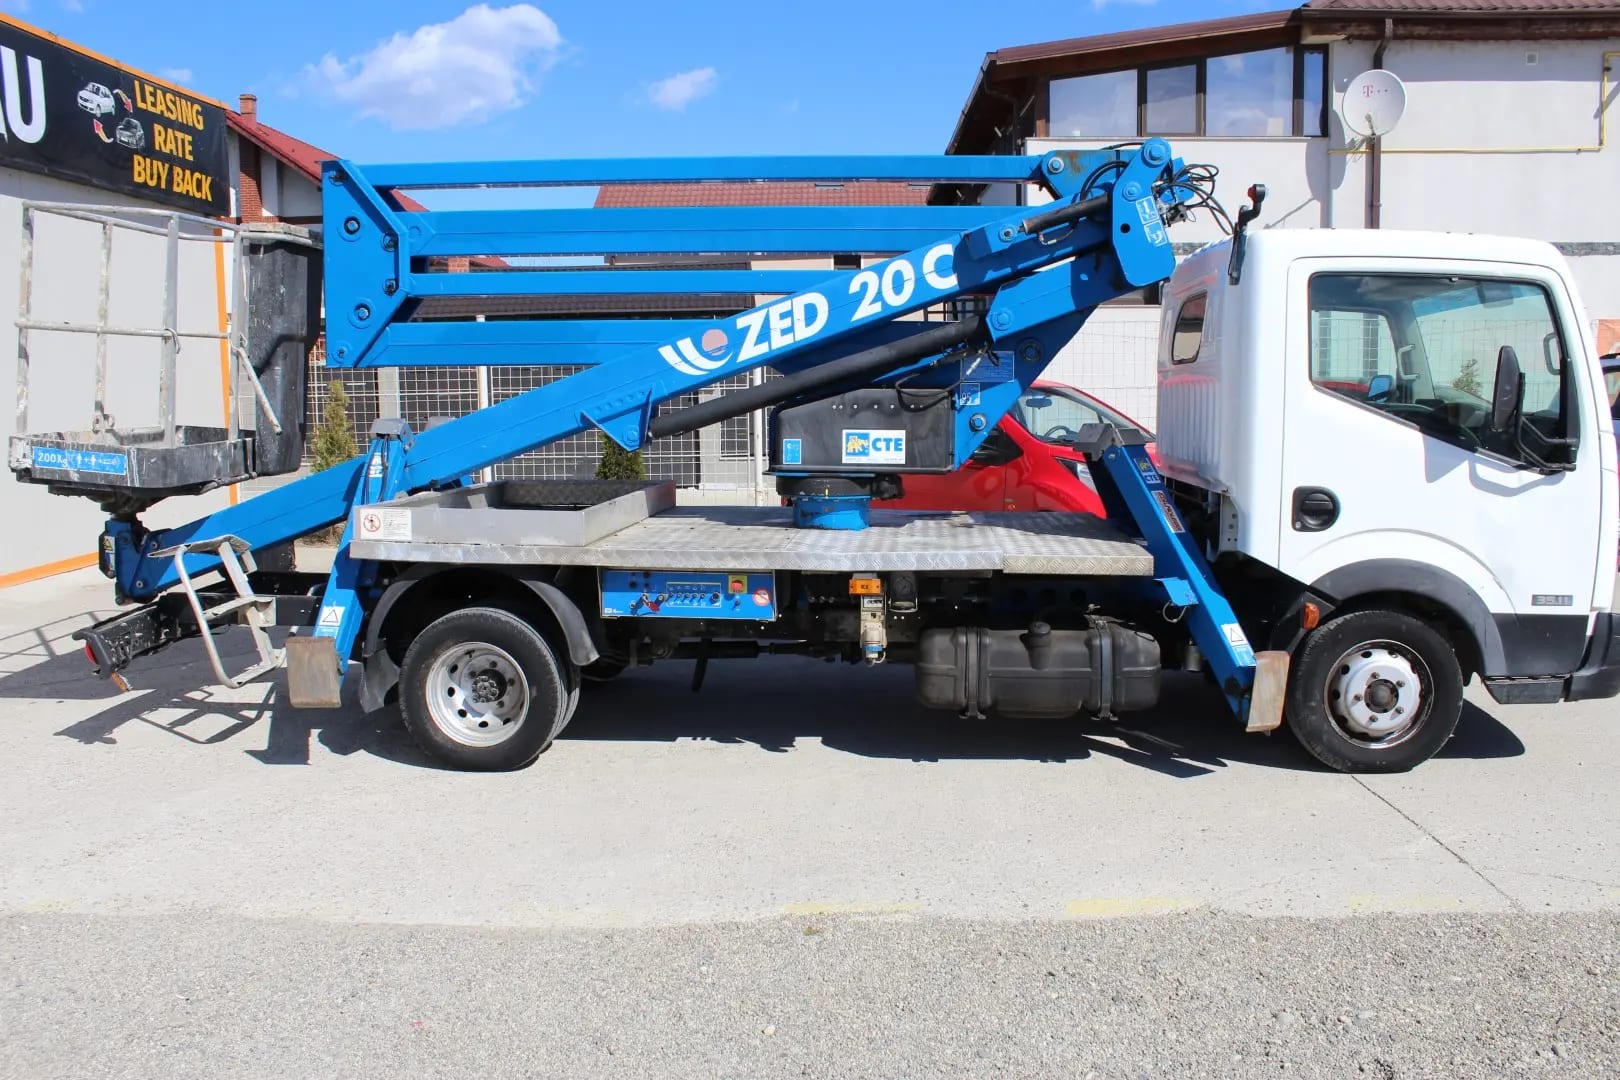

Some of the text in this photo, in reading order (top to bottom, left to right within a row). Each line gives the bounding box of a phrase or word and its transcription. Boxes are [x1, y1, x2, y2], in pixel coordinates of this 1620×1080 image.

[0, 45, 46, 143] U
[134, 79, 204, 130] LEASING
[153, 123, 193, 161] RATE
[133, 155, 212, 202] BUY BACK
[736, 244, 957, 363] ZED 20 C
[871, 437, 904, 452] CTE
